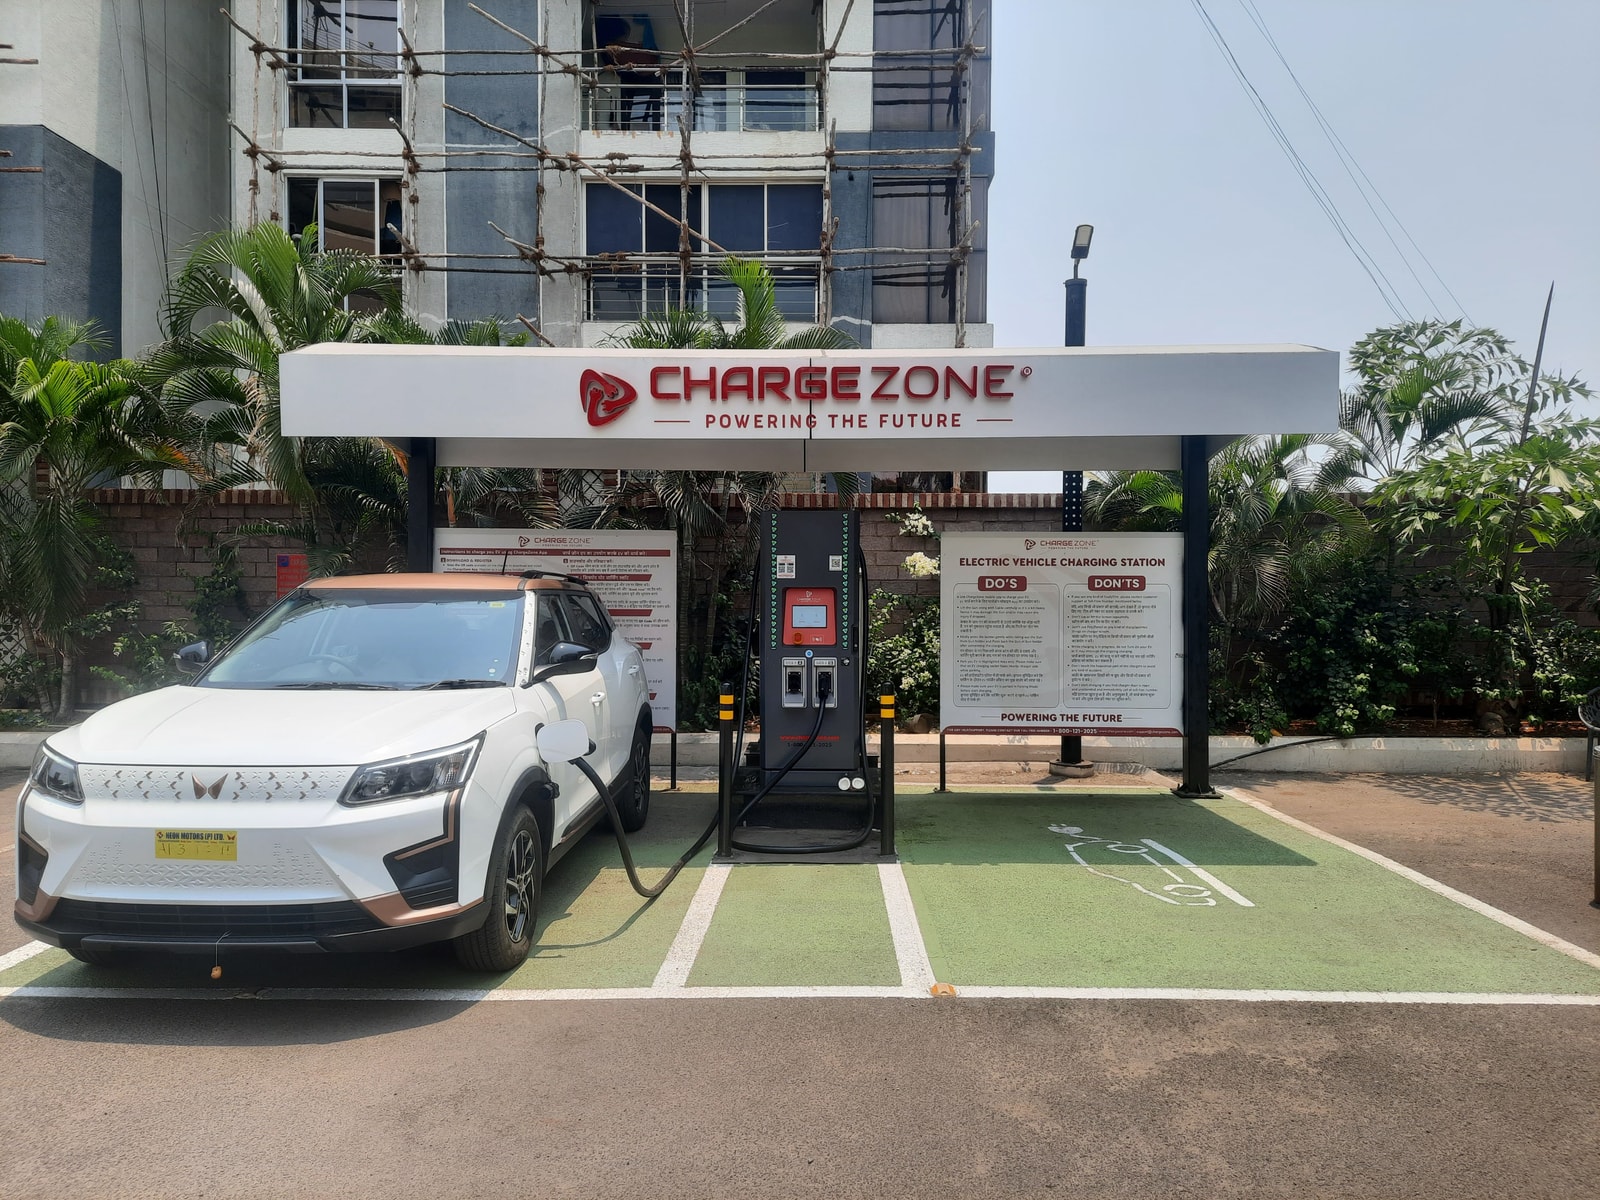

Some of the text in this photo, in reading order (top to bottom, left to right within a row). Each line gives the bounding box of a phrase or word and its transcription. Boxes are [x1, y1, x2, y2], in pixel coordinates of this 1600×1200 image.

[705, 413, 962, 429] POWERING THE FUTURE
[960, 558, 1166, 567] ELECTRIC VEHICLE CHARGING STATION
[985, 578, 1018, 589] DO'S
[1094, 578, 1140, 588] DON'TS
[1001, 713, 1123, 722] POWERING THE FUTURE
[181, 832, 204, 841] MOTORS
